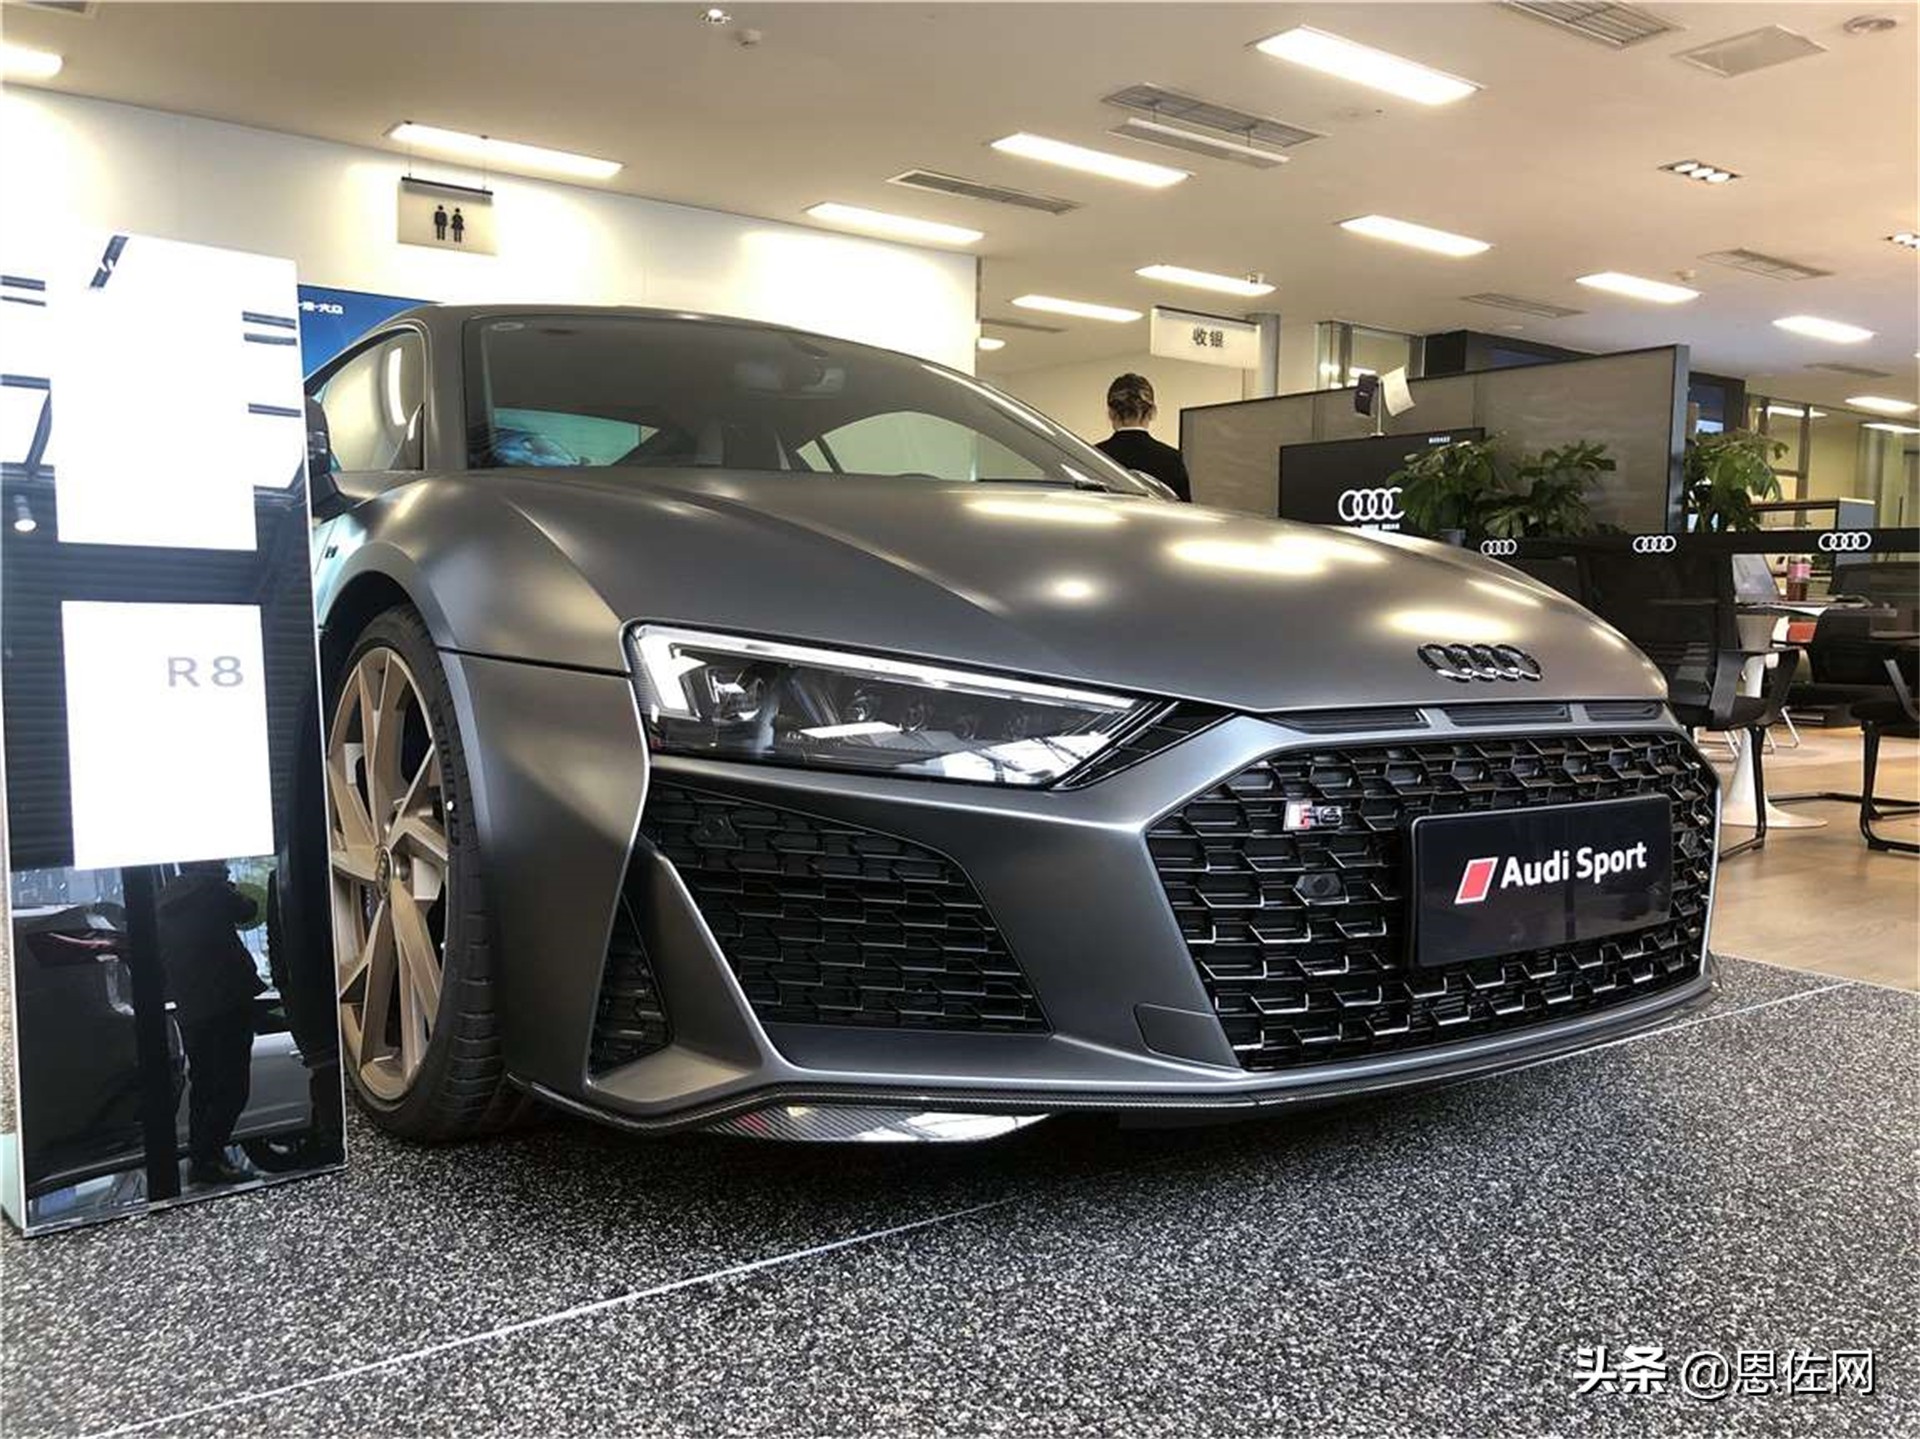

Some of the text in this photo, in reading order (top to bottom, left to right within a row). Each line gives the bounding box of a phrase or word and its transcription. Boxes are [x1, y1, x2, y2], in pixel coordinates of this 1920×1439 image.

[1193, 327, 1224, 348] 收银
[1500, 841, 1648, 889] Audi Sport
